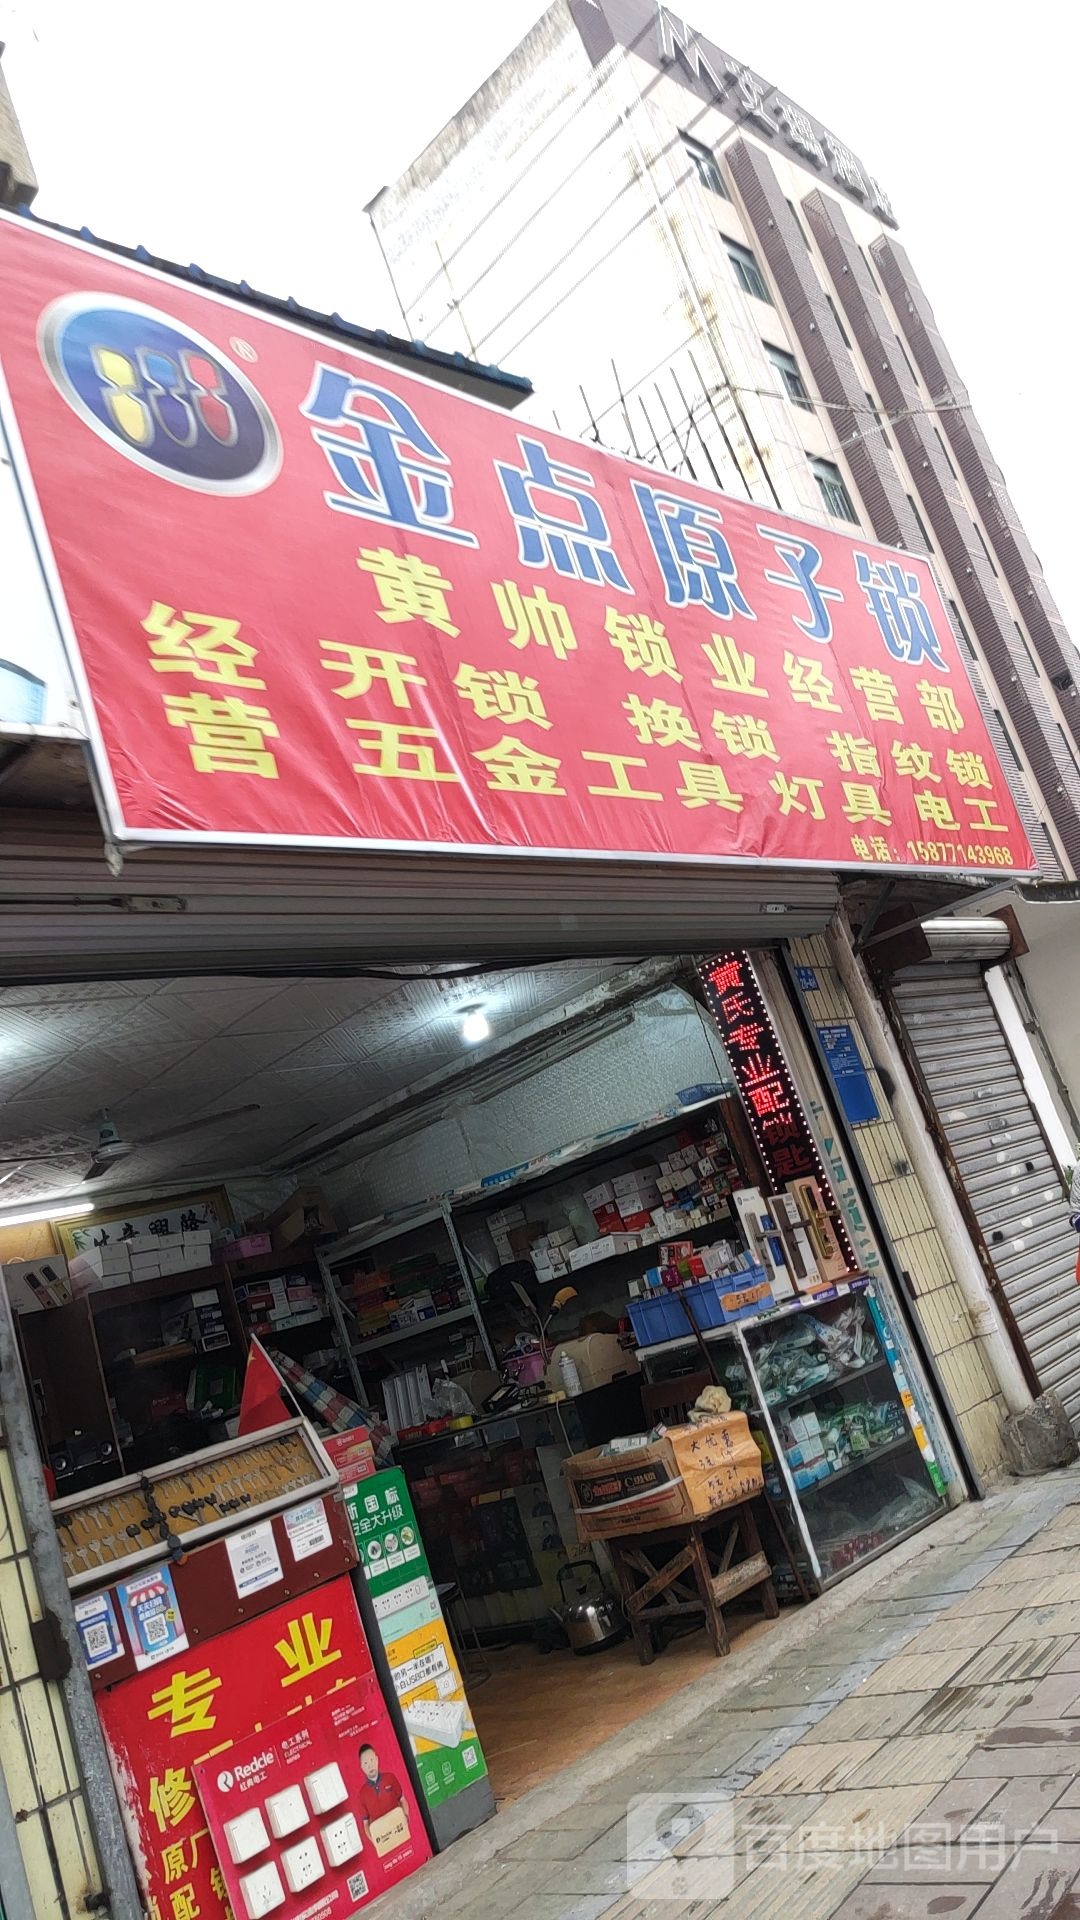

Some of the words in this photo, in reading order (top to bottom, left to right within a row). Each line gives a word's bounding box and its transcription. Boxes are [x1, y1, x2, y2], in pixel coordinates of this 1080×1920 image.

[299, 360, 950, 672] 金点原子锁
[140, 601, 280, 779] 经营
[356, 546, 965, 735] 黄帅锁业经营部
[319, 638, 554, 730] 开锁
[622, 693, 780, 763] 换锁
[831, 730, 992, 790] 指纹锁
[346, 718, 744, 814] 五金工具
[768, 770, 892, 827] 灯具
[914, 791, 1010, 833] 电工
[907, 840, 1014, 866] 15877143968
[147, 1612, 342, 1739] 专业
[234, 1750, 275, 1782] Redcle
